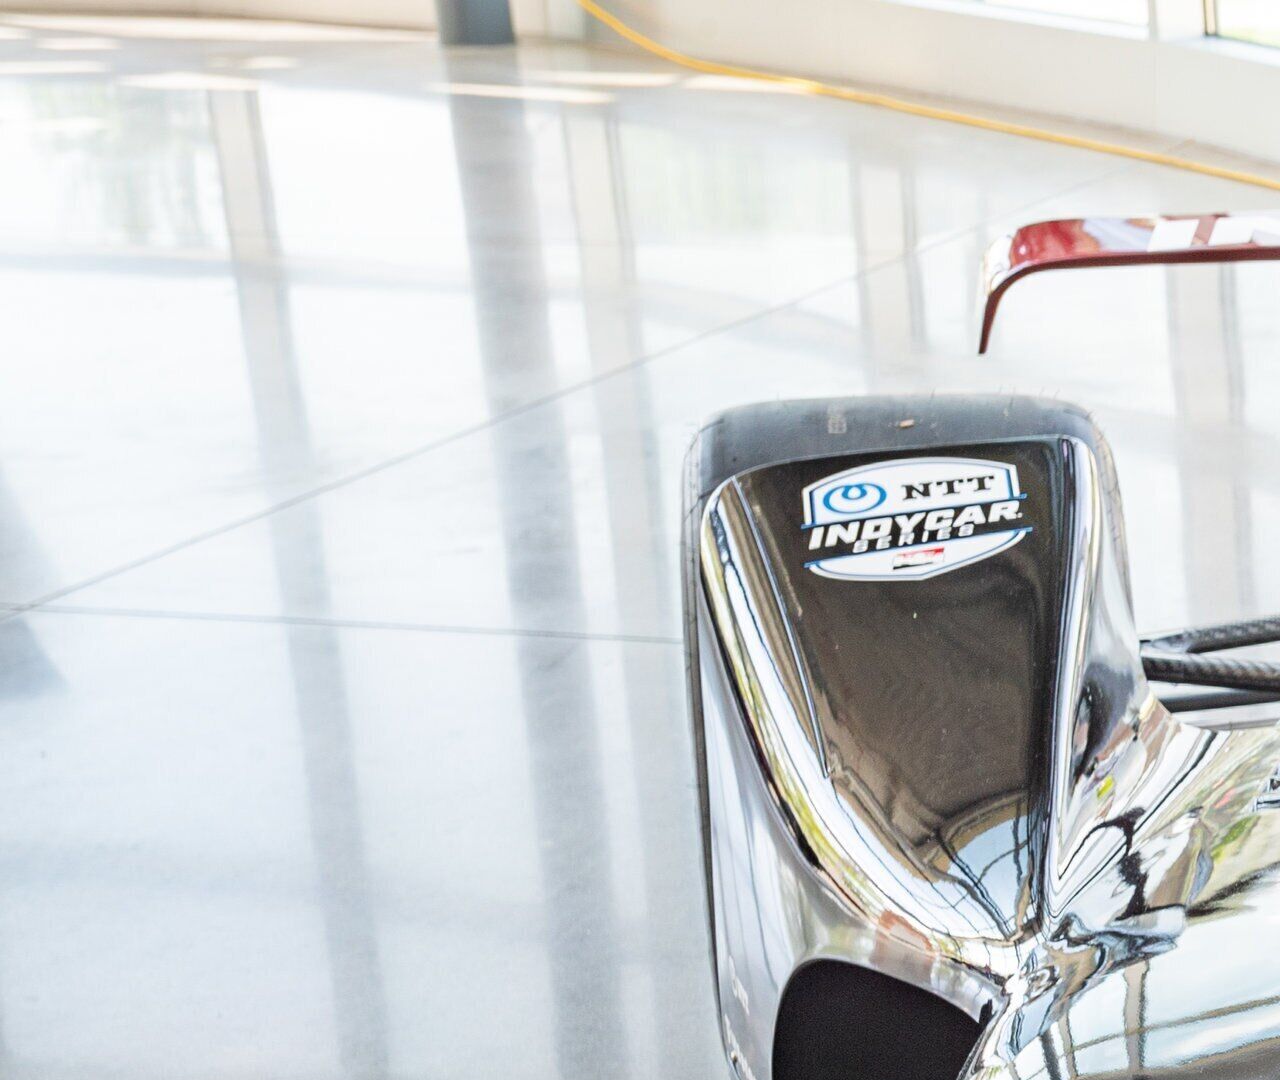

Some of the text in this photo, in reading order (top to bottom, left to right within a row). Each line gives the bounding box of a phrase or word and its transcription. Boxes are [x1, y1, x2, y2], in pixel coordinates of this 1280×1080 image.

[901, 475, 996, 501] NTT
[808, 500, 1022, 550] INDYCAR
[852, 524, 975, 553] SERIES
